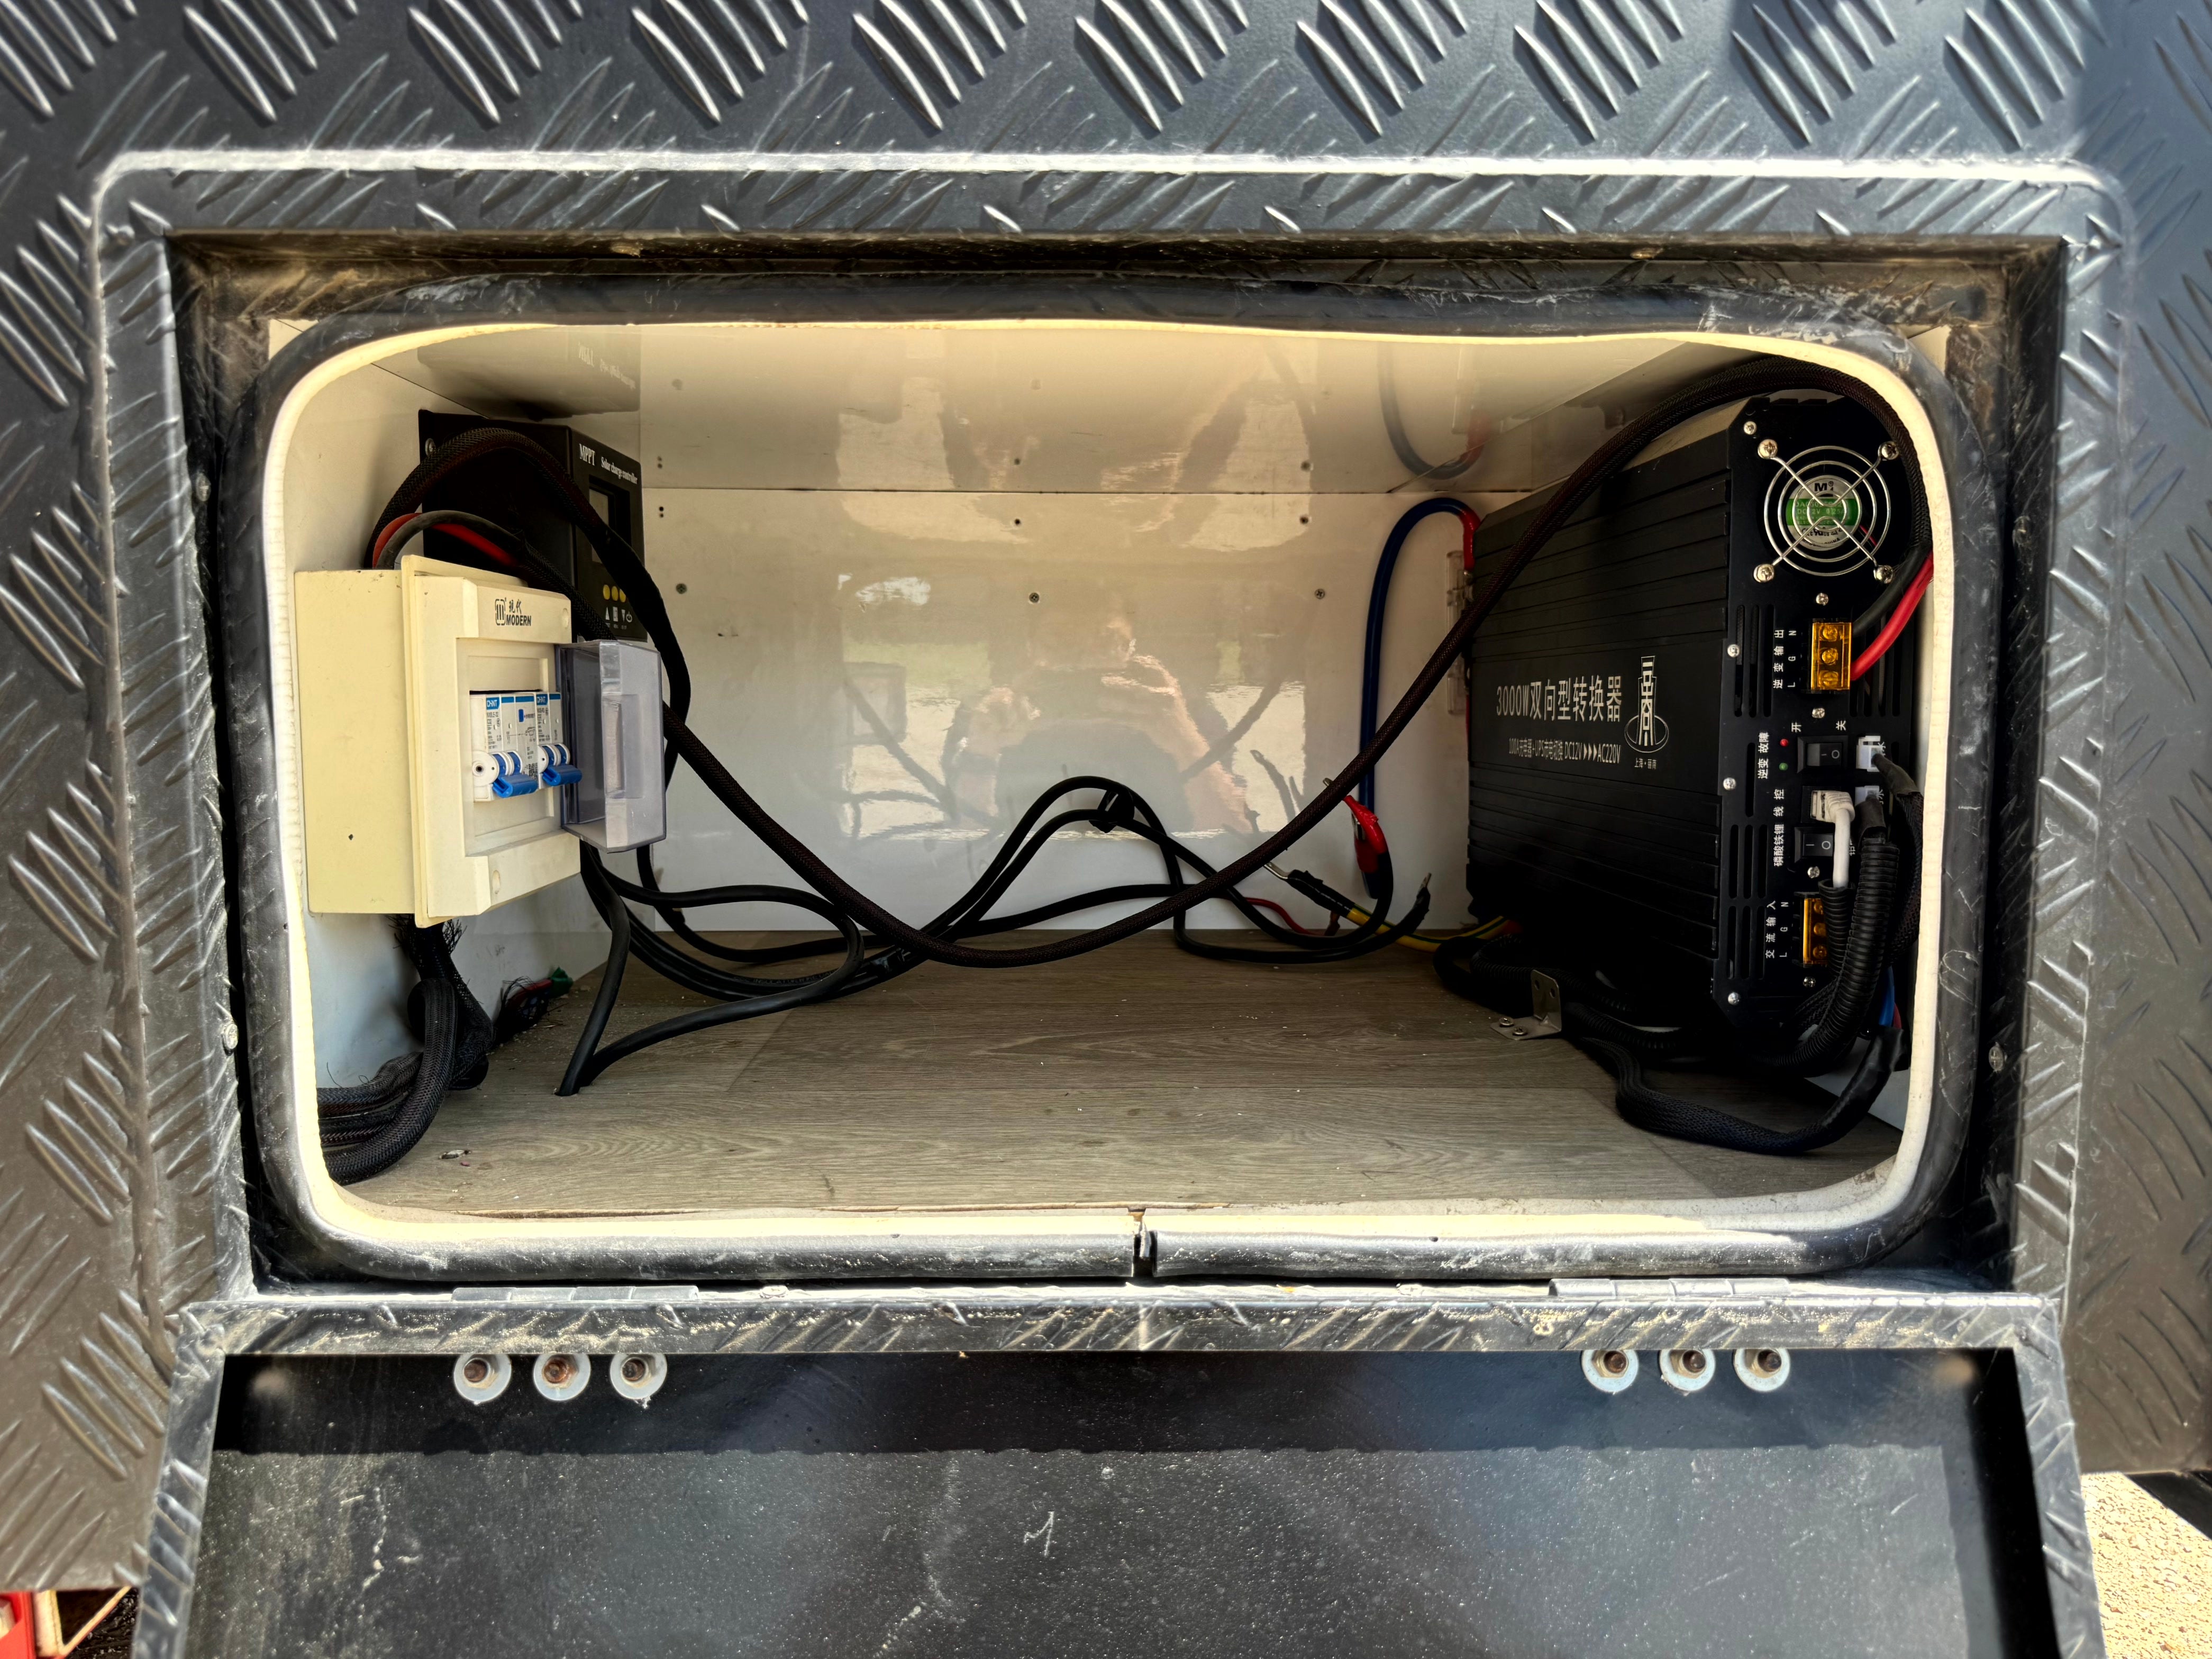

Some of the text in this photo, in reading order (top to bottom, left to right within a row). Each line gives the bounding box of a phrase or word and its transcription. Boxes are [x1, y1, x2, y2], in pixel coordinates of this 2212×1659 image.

[579, 443, 638, 484] MPPT Solar charge controller
[506, 615, 531, 626] MODERN
[1773, 630, 1785, 689] 逆变输出
[1497, 674, 1622, 722] 3000W双向型转换器
[1791, 722, 1801, 733] 开
[1836, 720, 1846, 731] 关
[1758, 732, 1769, 753] 故障
[1758, 758, 1769, 779] 逆变
[1773, 789, 1785, 817] 线控
[1773, 824, 1785, 867] 磷酸铁锂
[1765, 900, 1777, 959] 交流输入
